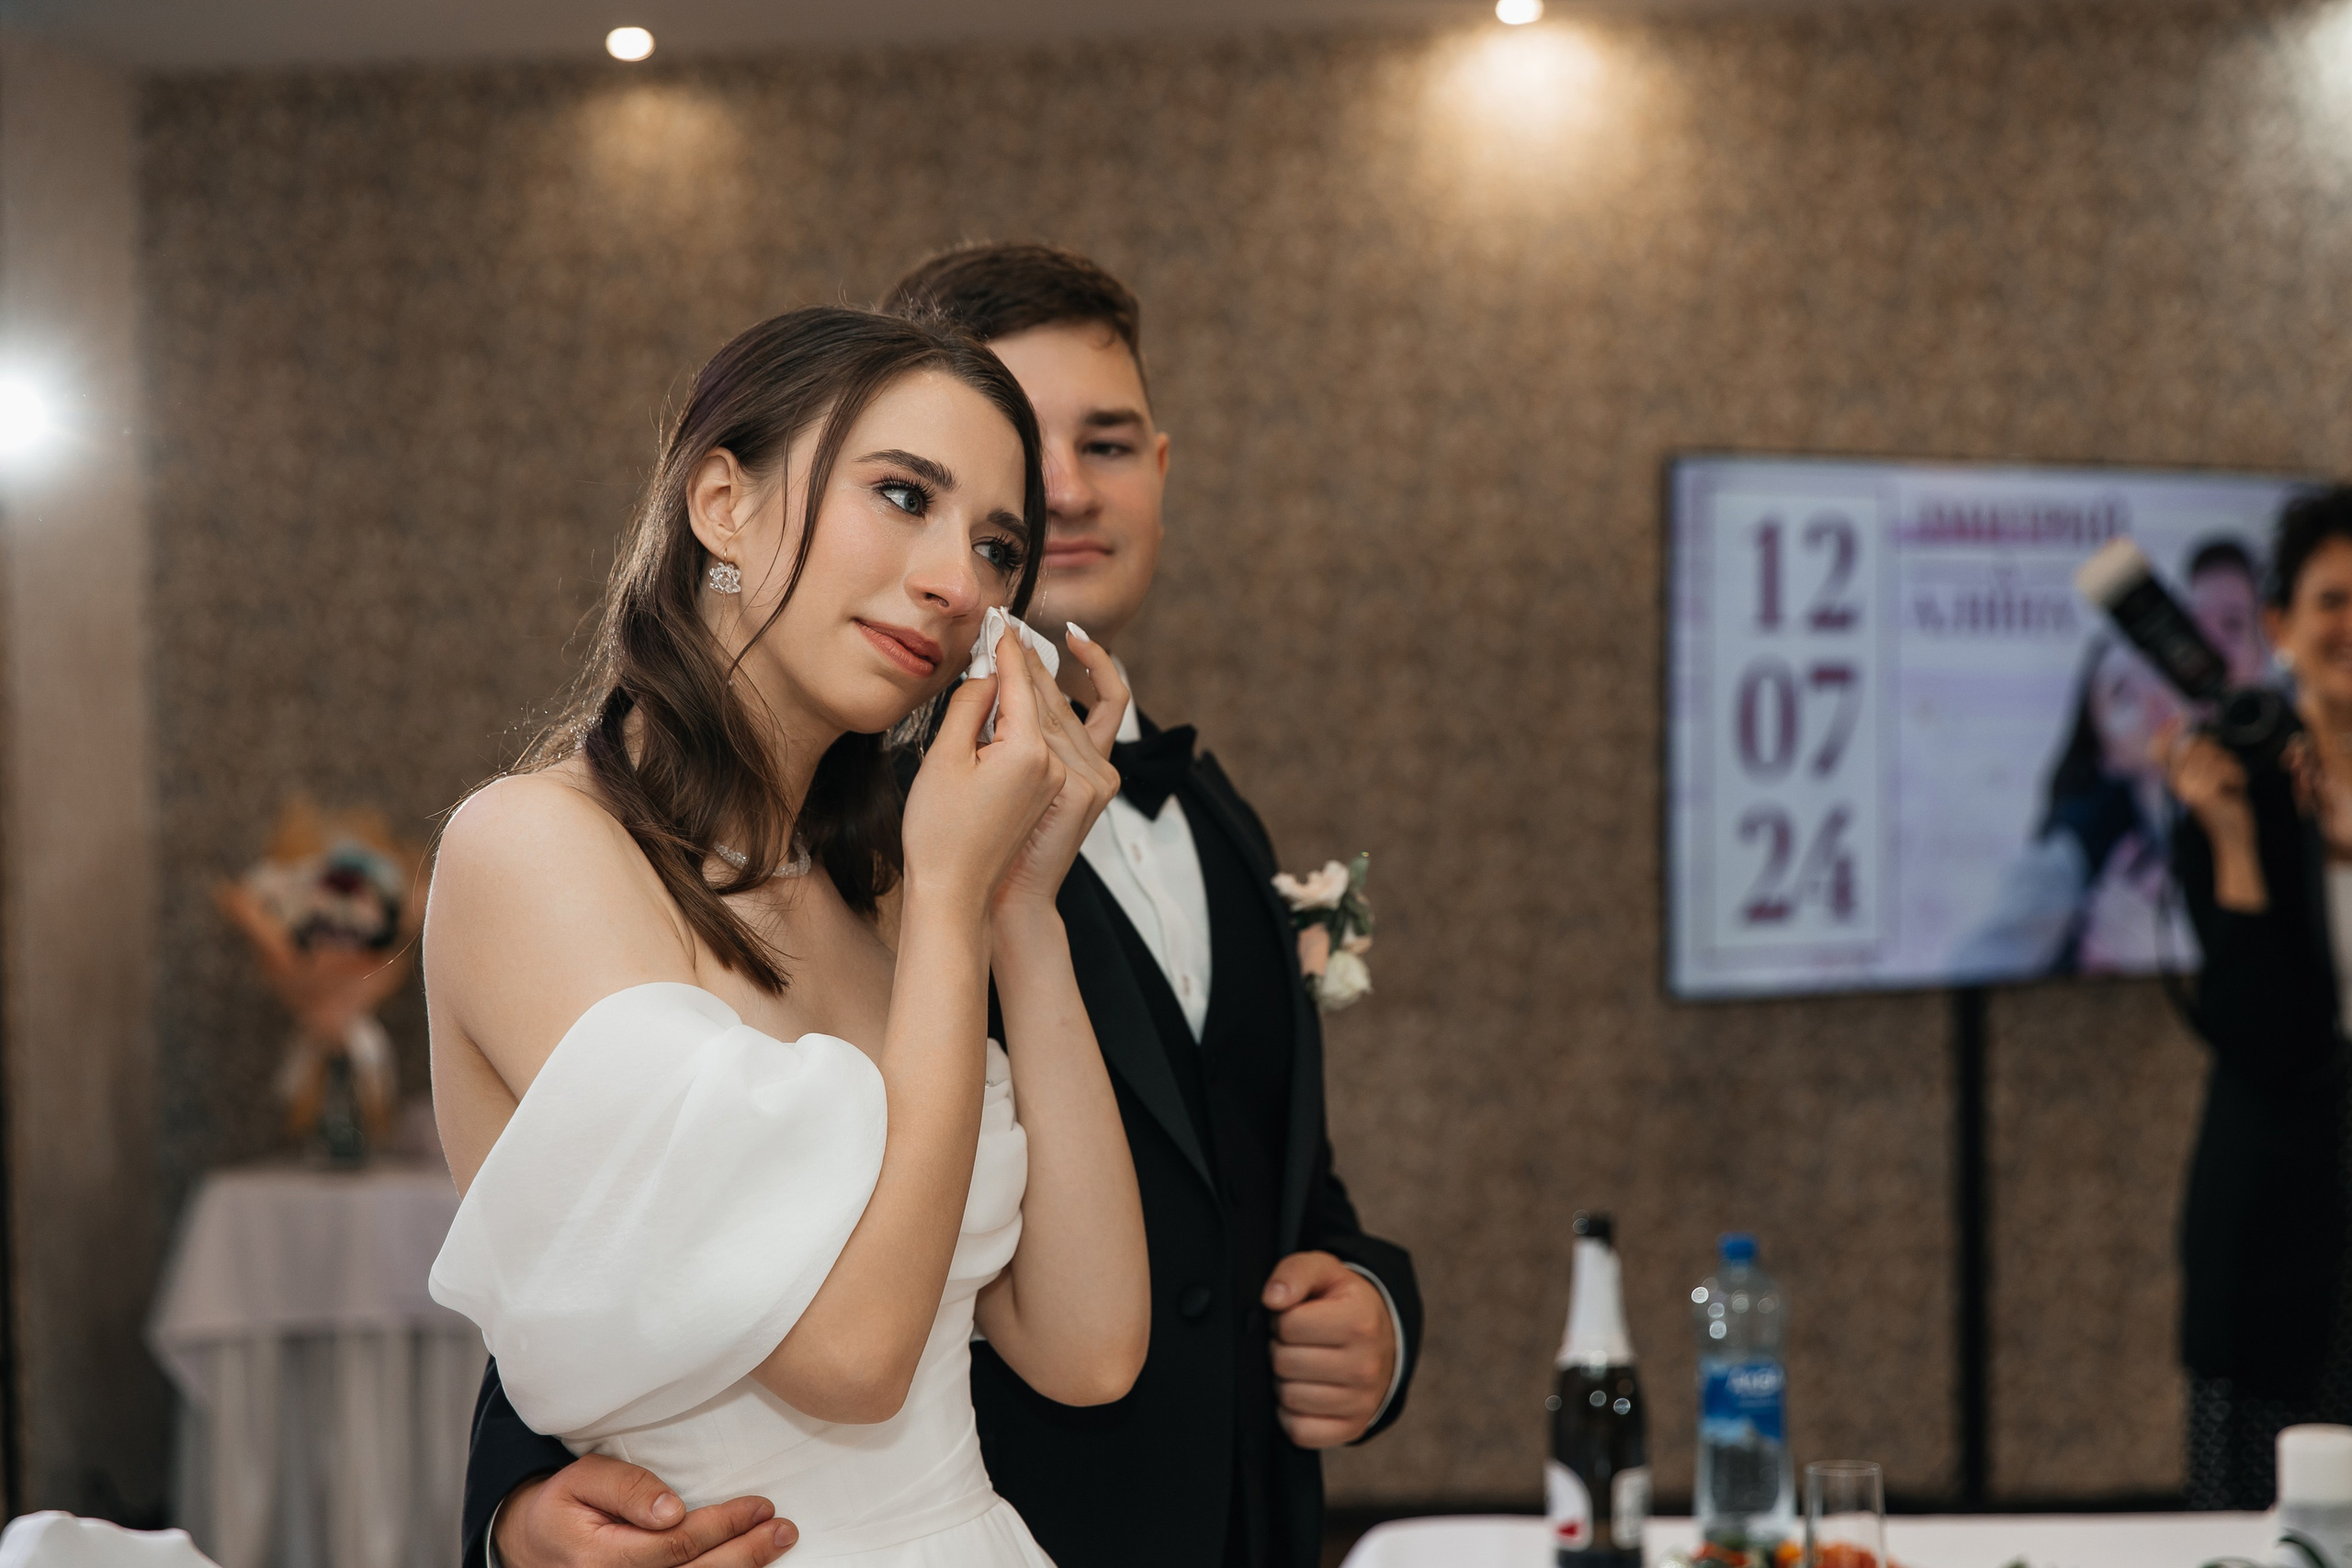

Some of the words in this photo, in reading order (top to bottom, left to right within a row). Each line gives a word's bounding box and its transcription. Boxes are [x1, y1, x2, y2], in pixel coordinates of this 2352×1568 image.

[1746, 515, 1859, 631] 12
[1735, 660, 1859, 780] 07
[1736, 807, 1859, 924] 24
